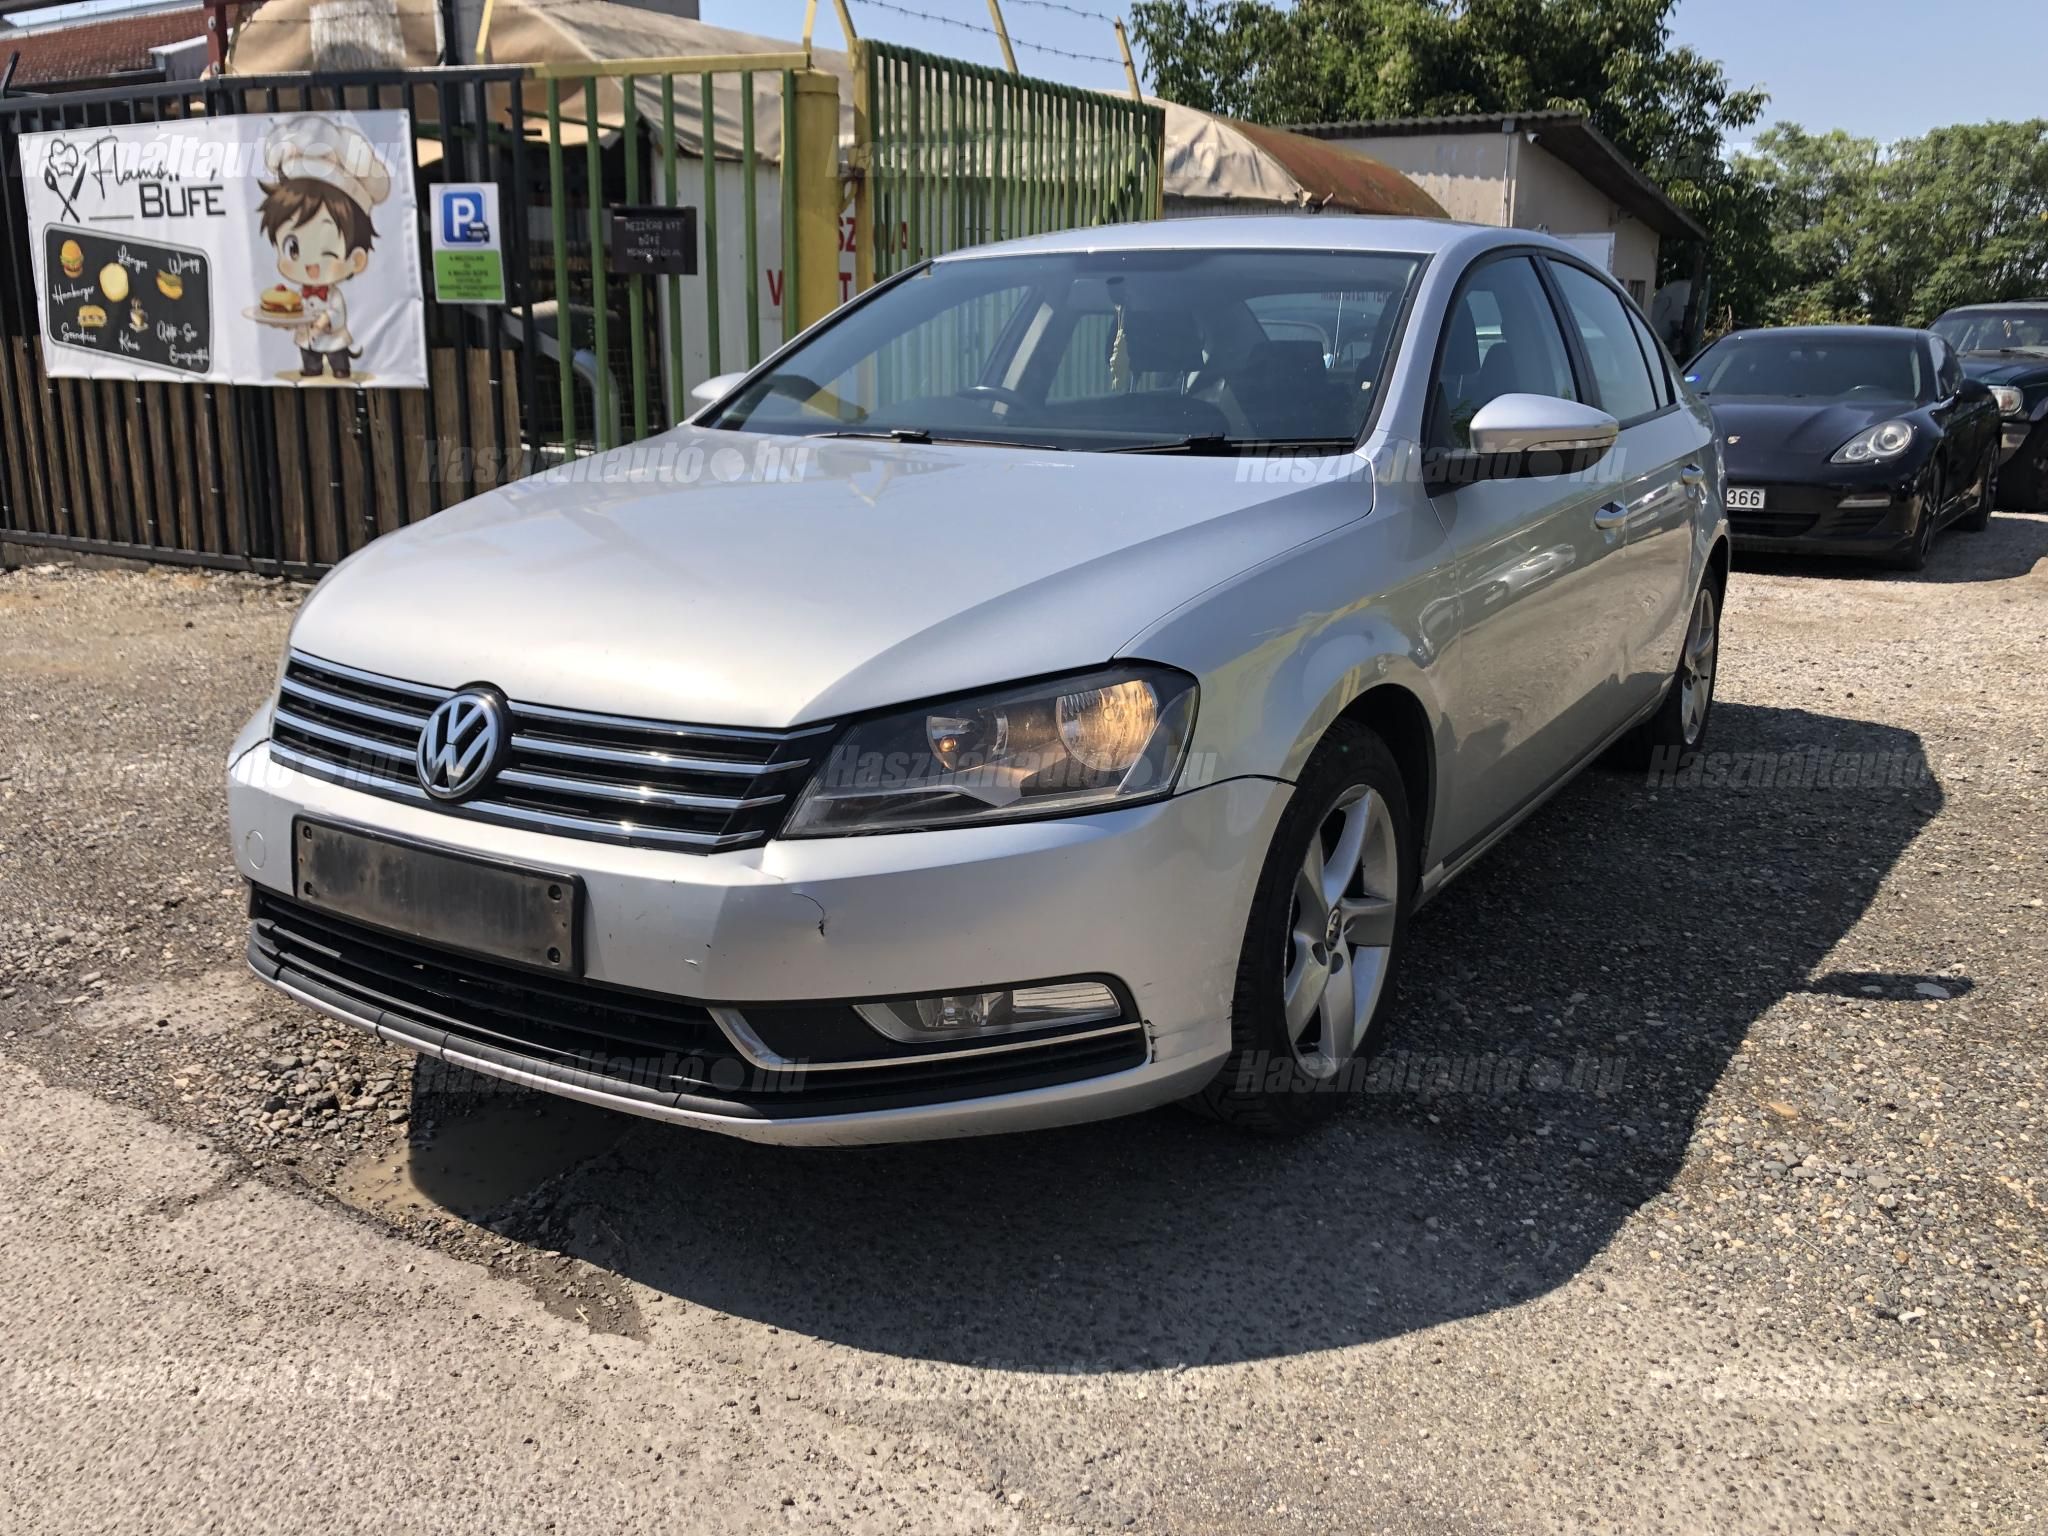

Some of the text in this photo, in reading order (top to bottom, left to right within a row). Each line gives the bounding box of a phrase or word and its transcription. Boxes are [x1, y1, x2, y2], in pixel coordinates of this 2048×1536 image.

[138, 167, 226, 219] BÜFÉ
[452, 198, 475, 238] P
[1727, 489, 1760, 506] 366
